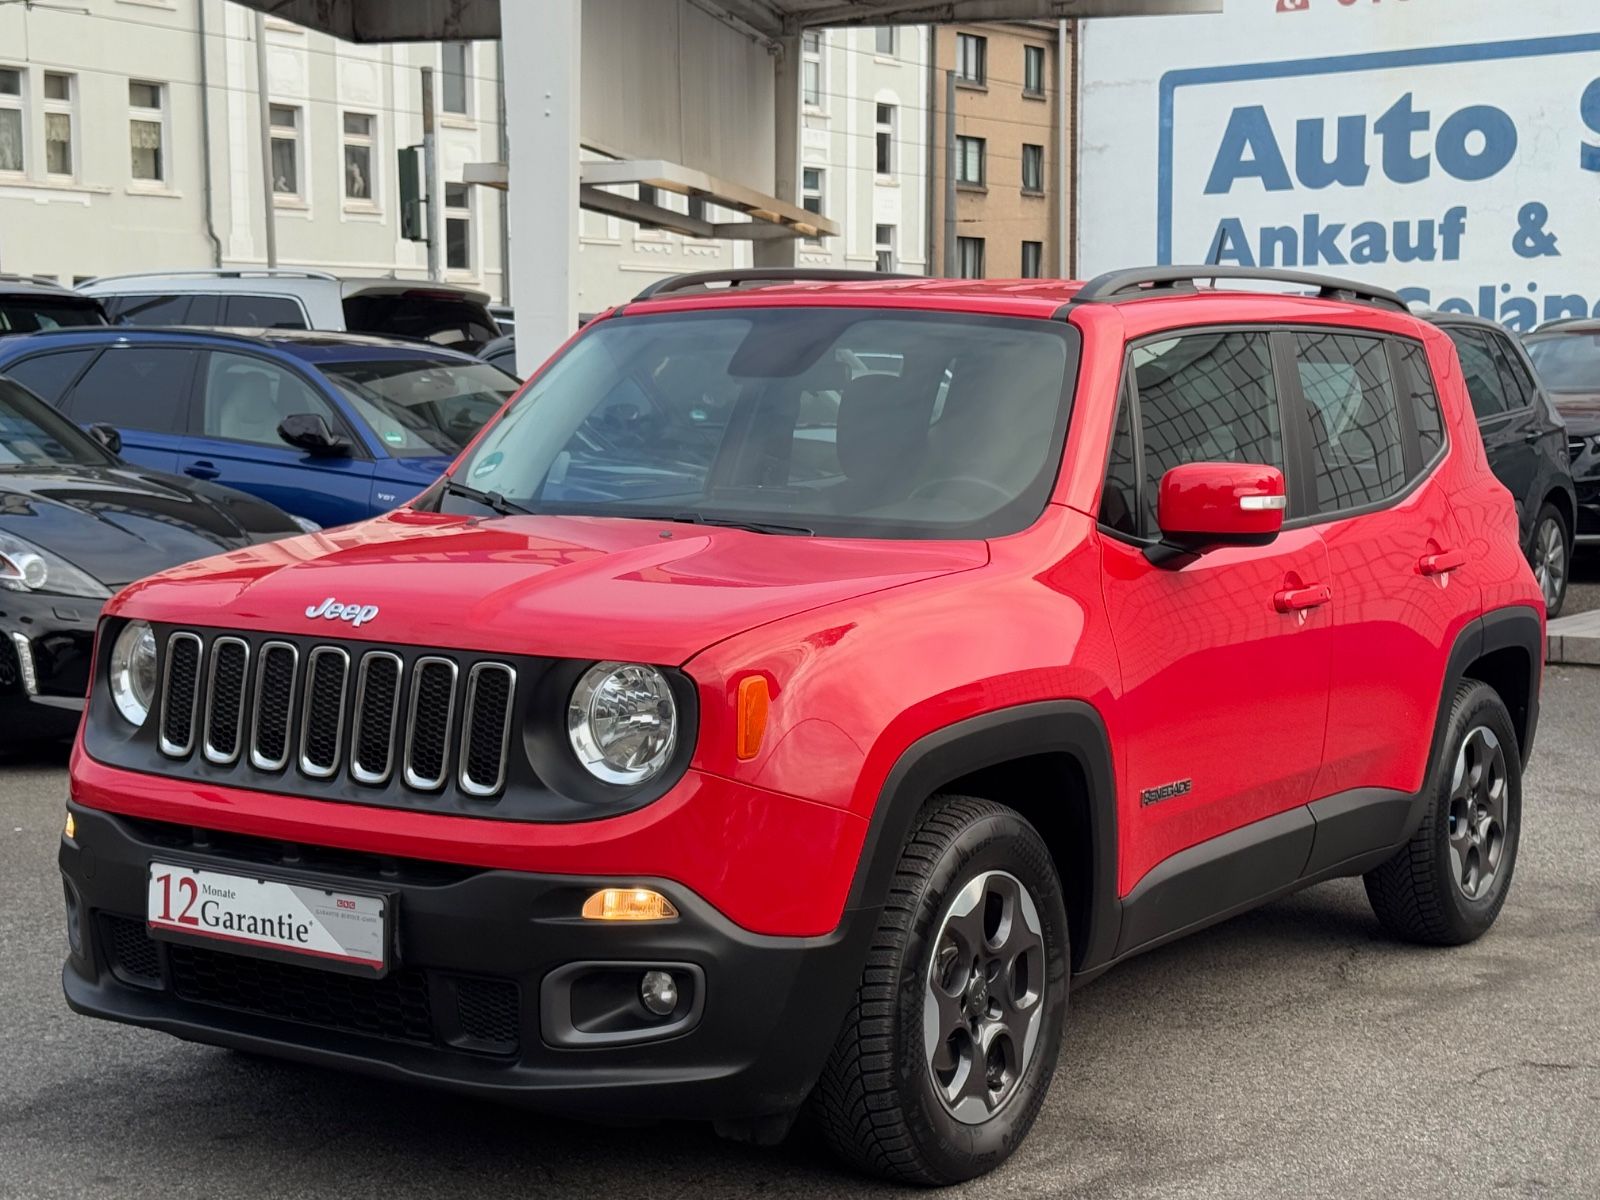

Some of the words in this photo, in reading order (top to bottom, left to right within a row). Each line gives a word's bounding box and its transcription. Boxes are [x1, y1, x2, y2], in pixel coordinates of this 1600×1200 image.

[1203, 92, 1518, 195] Auto
[1204, 206, 1467, 267] Ankauf
[1511, 201, 1562, 258] &
[305, 597, 379, 627] Jeep
[1140, 778, 1191, 807] RENEGADE
[156, 873, 199, 926] 12
[202, 883, 237, 900] Monate
